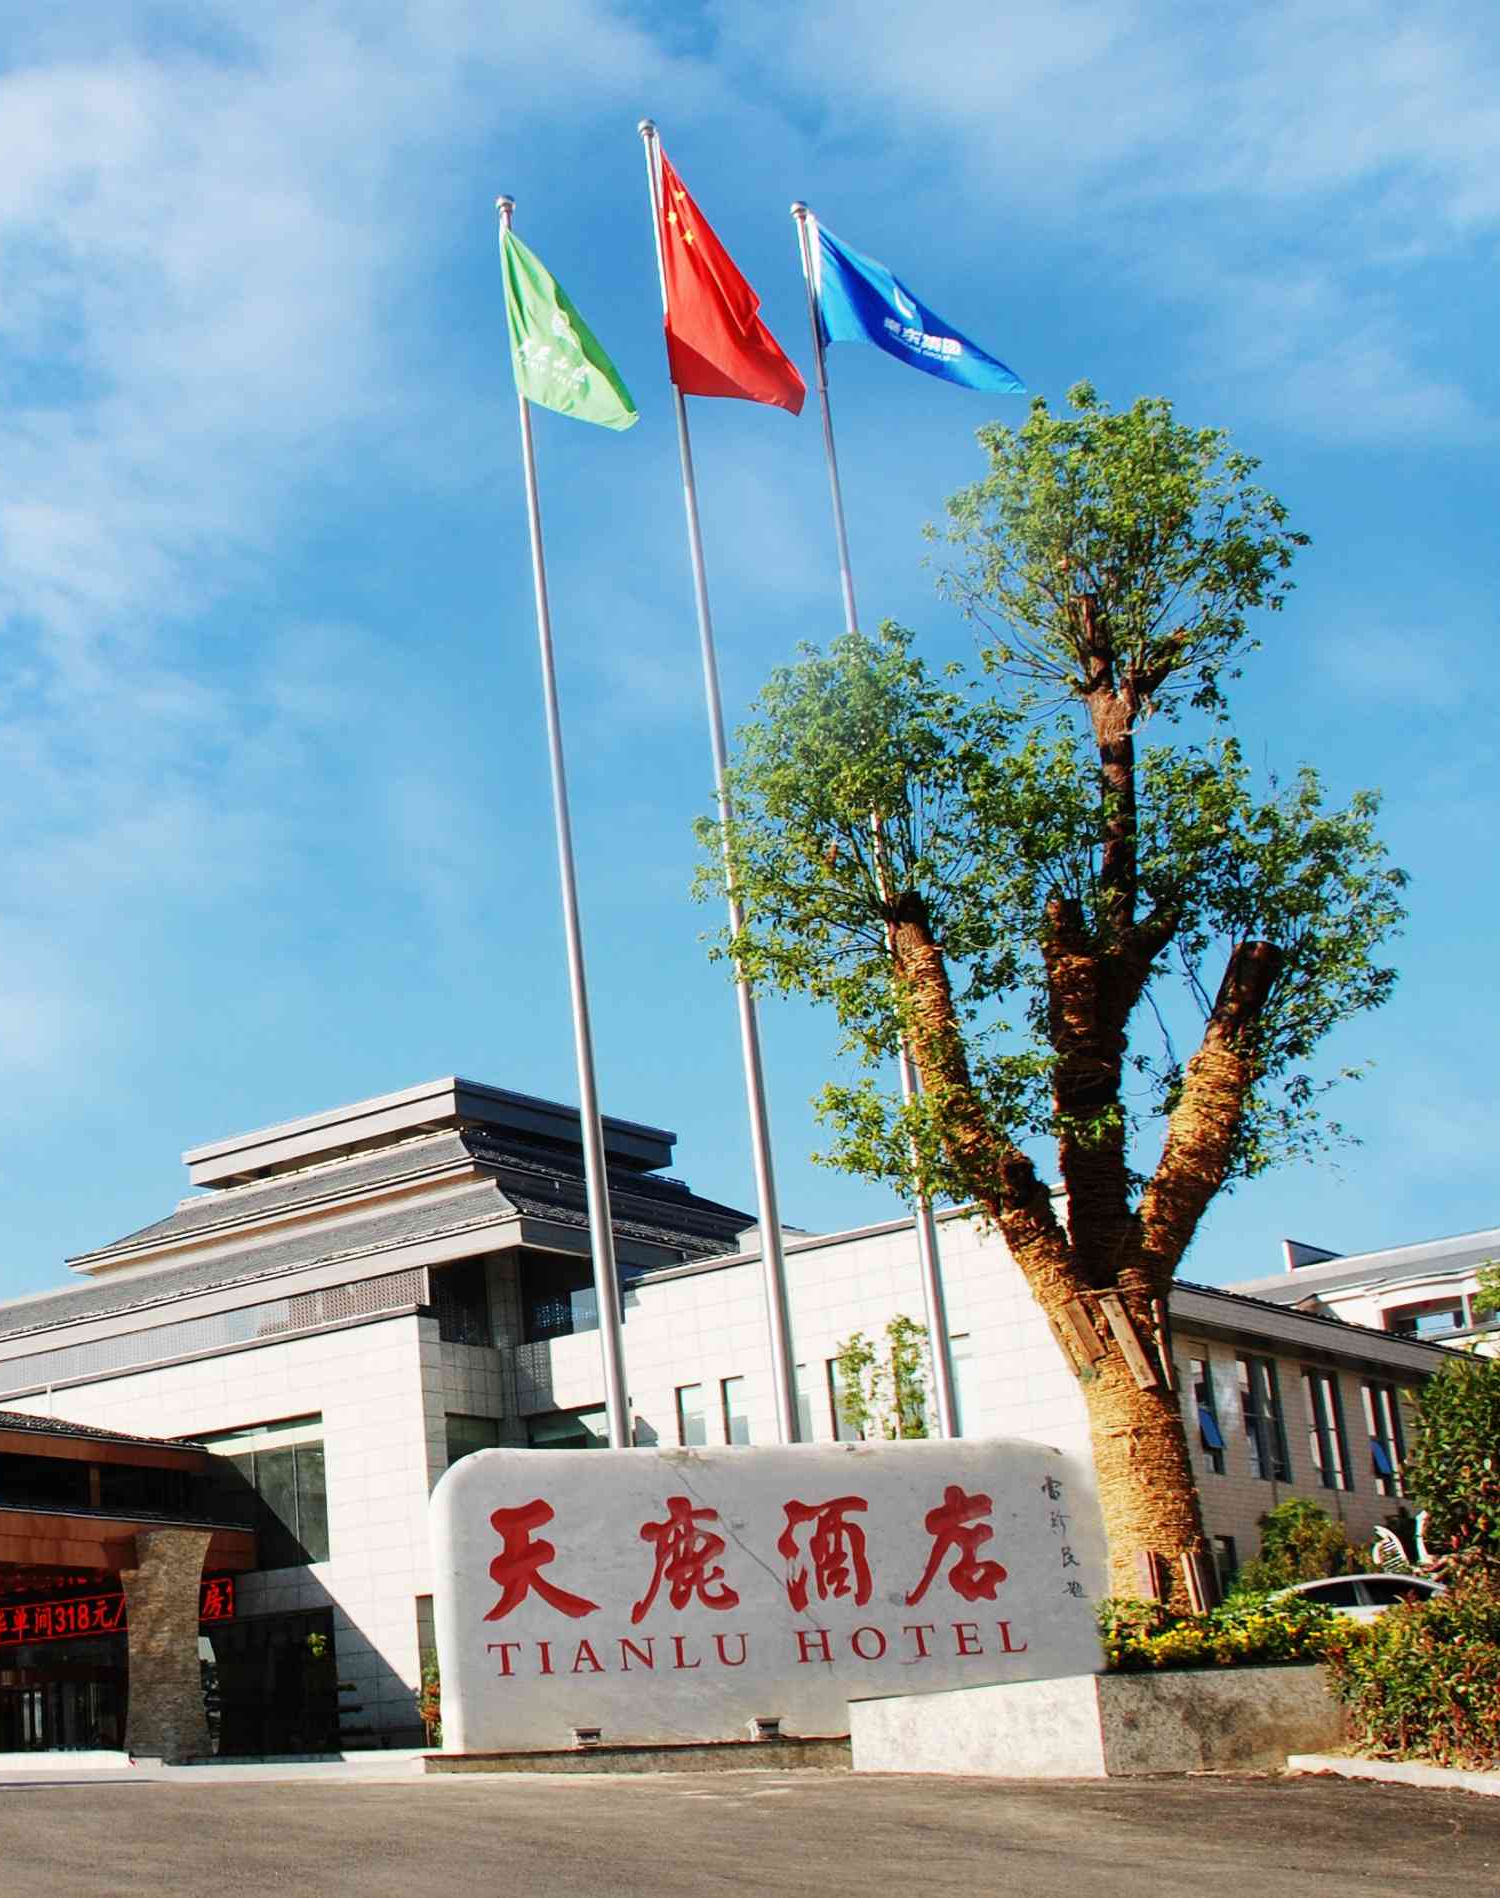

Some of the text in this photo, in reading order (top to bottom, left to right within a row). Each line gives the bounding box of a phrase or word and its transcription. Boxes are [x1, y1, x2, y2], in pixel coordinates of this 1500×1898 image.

[483, 1484, 1007, 1625] 天鹿酒店
[486, 1620, 1028, 1677] TIANLU HOTEL
